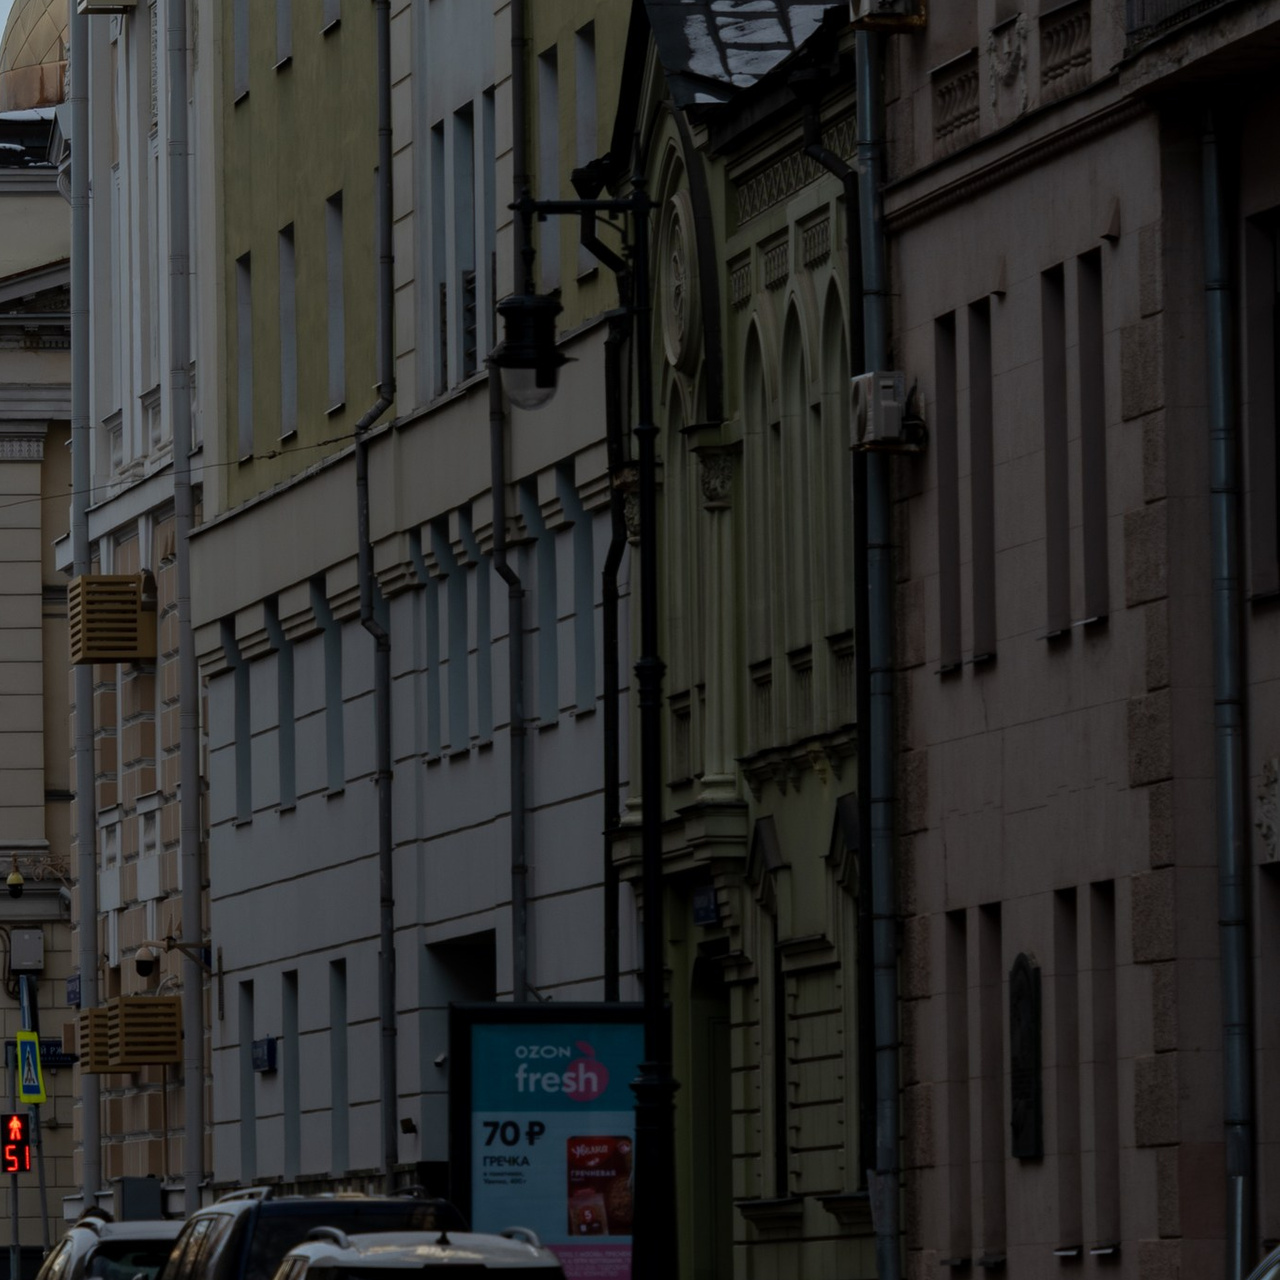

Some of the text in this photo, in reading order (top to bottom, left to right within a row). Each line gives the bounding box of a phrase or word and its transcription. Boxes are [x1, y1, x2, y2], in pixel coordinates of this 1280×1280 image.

[514, 1045, 572, 1059] OZON
[514, 1063, 598, 1093] fresh
[483, 1121, 520, 1146] 70
[4, 1144, 31, 1172] 51
[483, 1156, 530, 1167] ГРЕЧКА
[584, 1211, 592, 1220] 5
